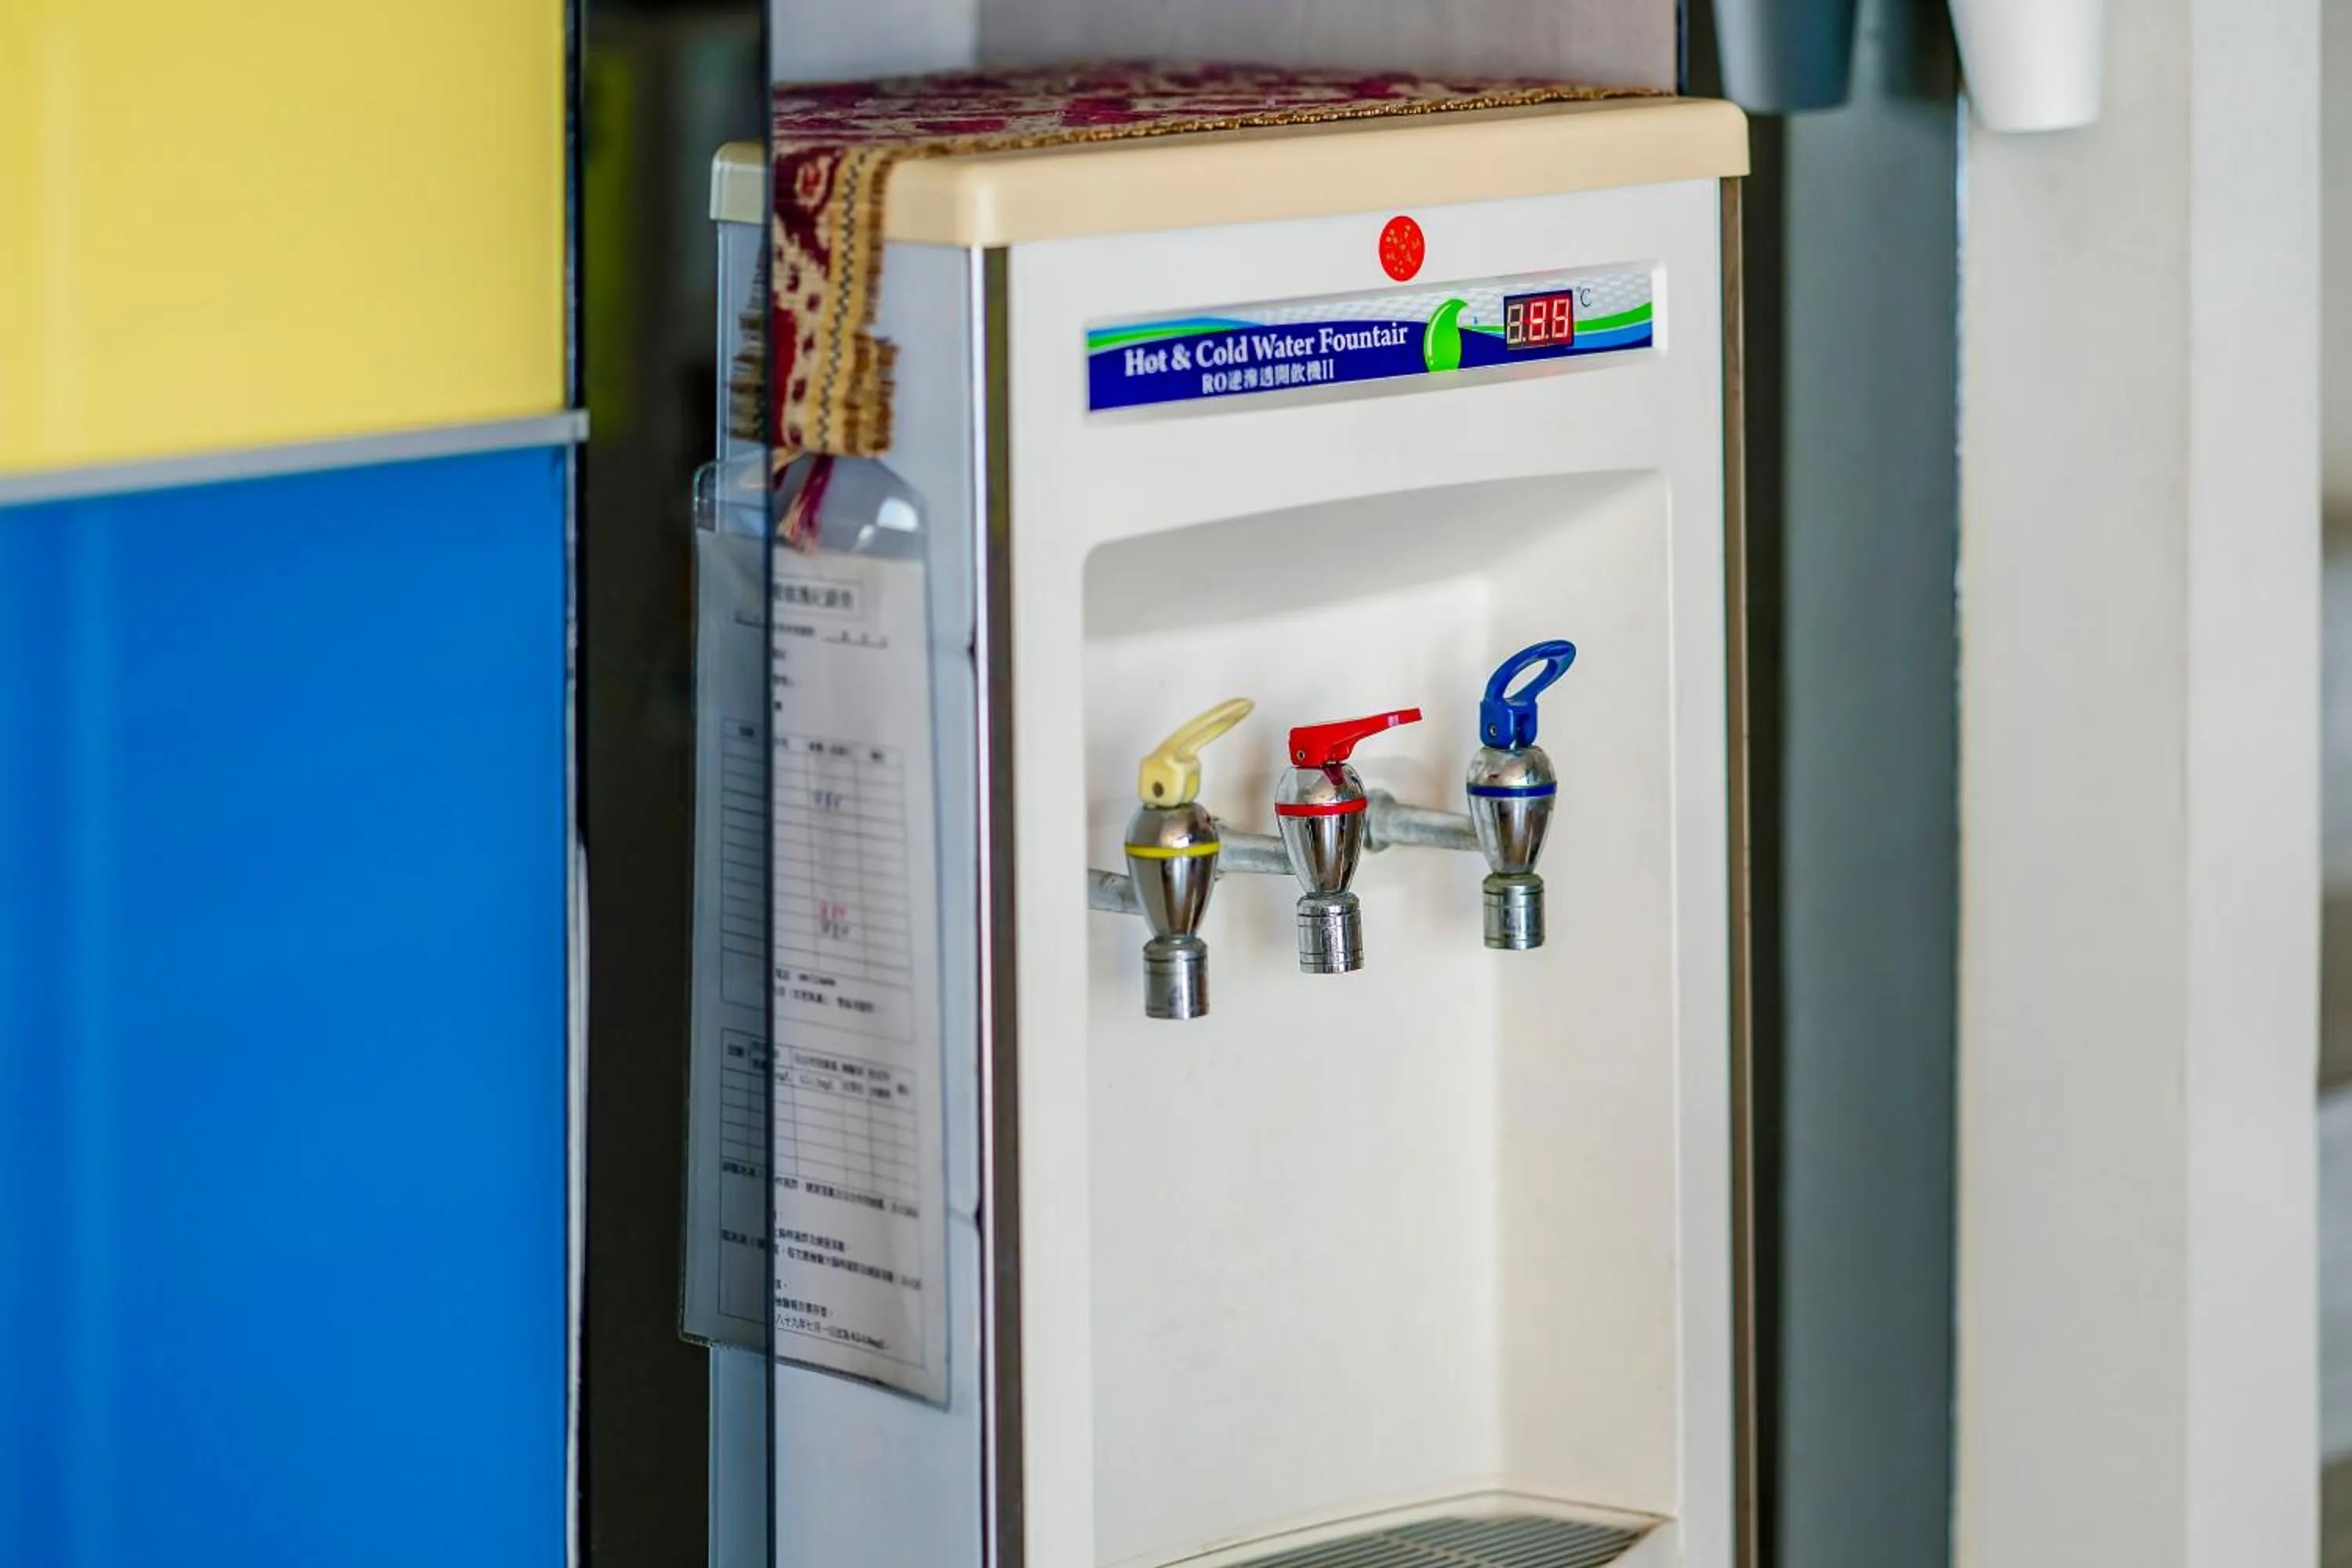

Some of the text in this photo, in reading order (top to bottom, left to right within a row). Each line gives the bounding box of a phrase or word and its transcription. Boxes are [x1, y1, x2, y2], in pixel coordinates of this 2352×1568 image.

[1124, 348, 1168, 376] Hot
[1171, 343, 1191, 370] &
[1196, 336, 1248, 367] Cold
[1251, 334, 1315, 361] Water
